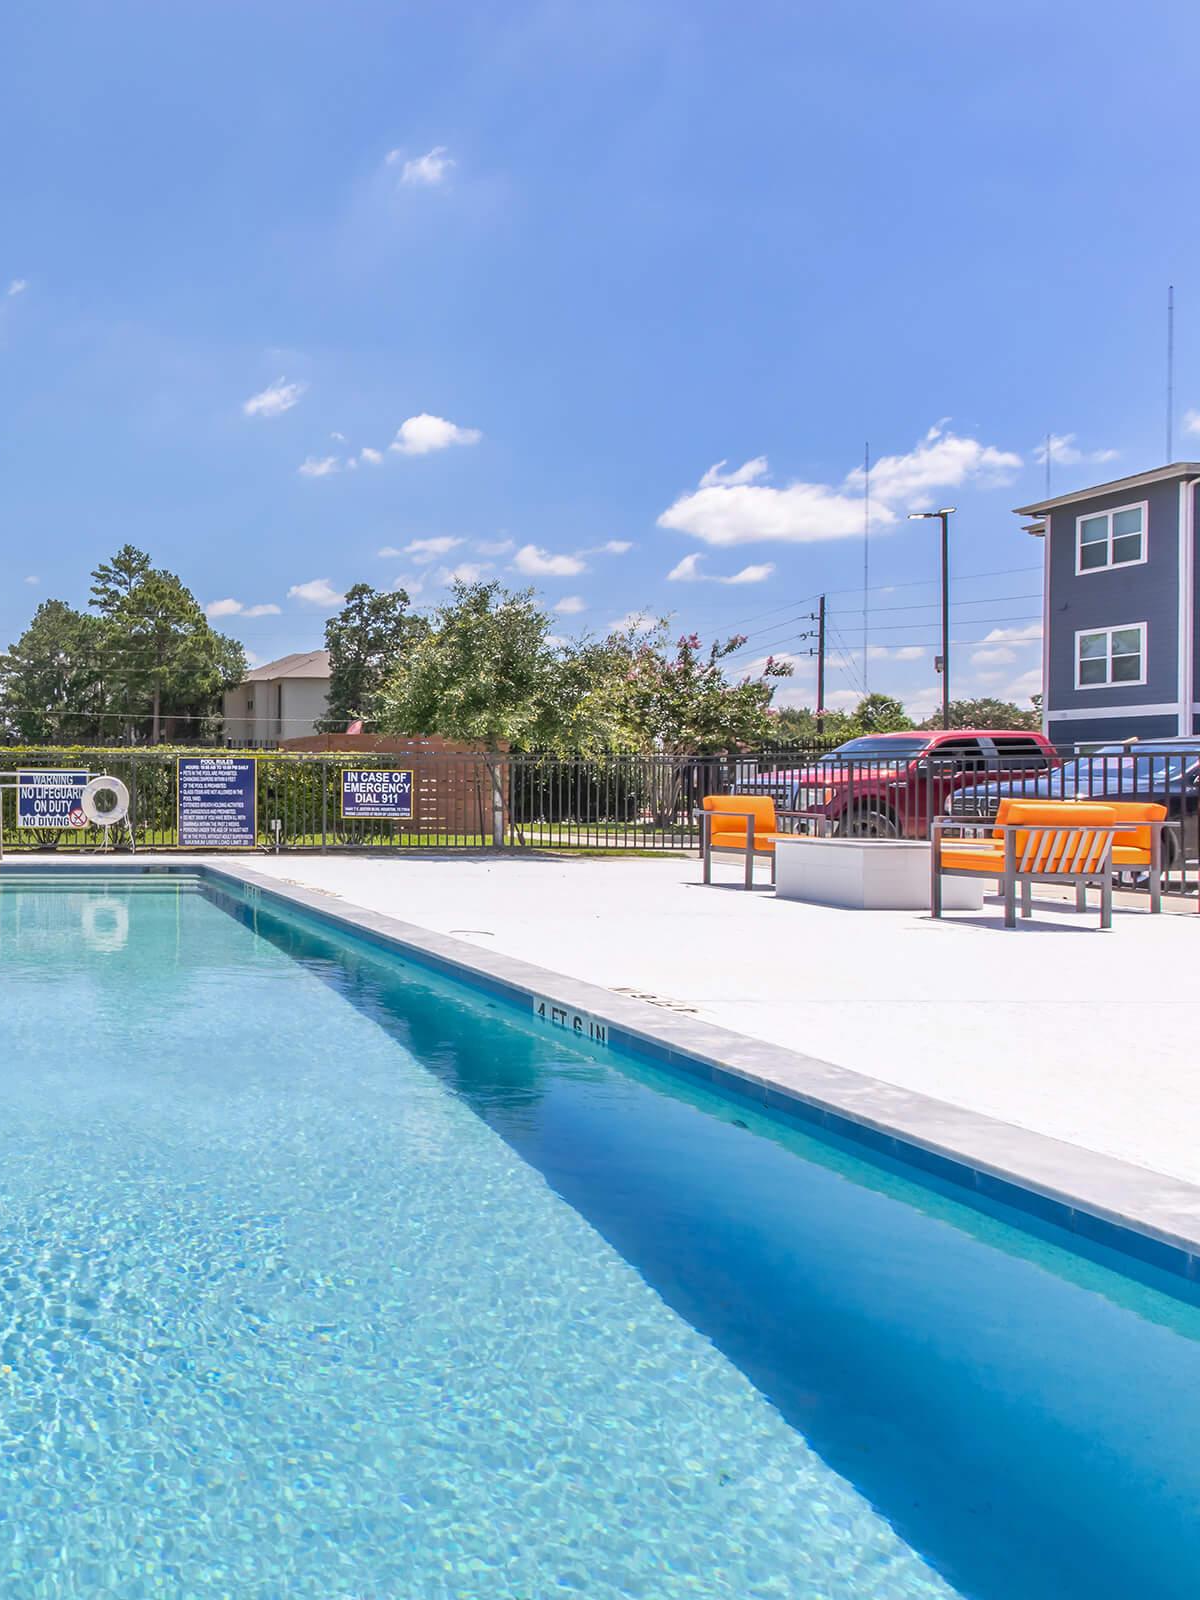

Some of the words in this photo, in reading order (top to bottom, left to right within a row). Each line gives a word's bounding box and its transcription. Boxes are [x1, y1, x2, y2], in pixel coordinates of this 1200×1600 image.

[33, 775, 73, 784] WARNING
[347, 772, 358, 782] IN
[360, 772, 390, 782] CASE
[392, 773, 407, 782] OF
[21, 787, 34, 799] NO
[344, 782, 410, 793] EMERGENCY
[355, 793, 380, 803] DIAL
[381, 794, 398, 804] 911
[34, 800, 47, 813] ON
[48, 800, 72, 813] DUTY
[22, 817, 35, 826] NO
[38, 817, 70, 826] DIVING
[537, 1002, 545, 1017] 4
[551, 1007, 567, 1025] FT
[590, 1022, 605, 1042] IN
